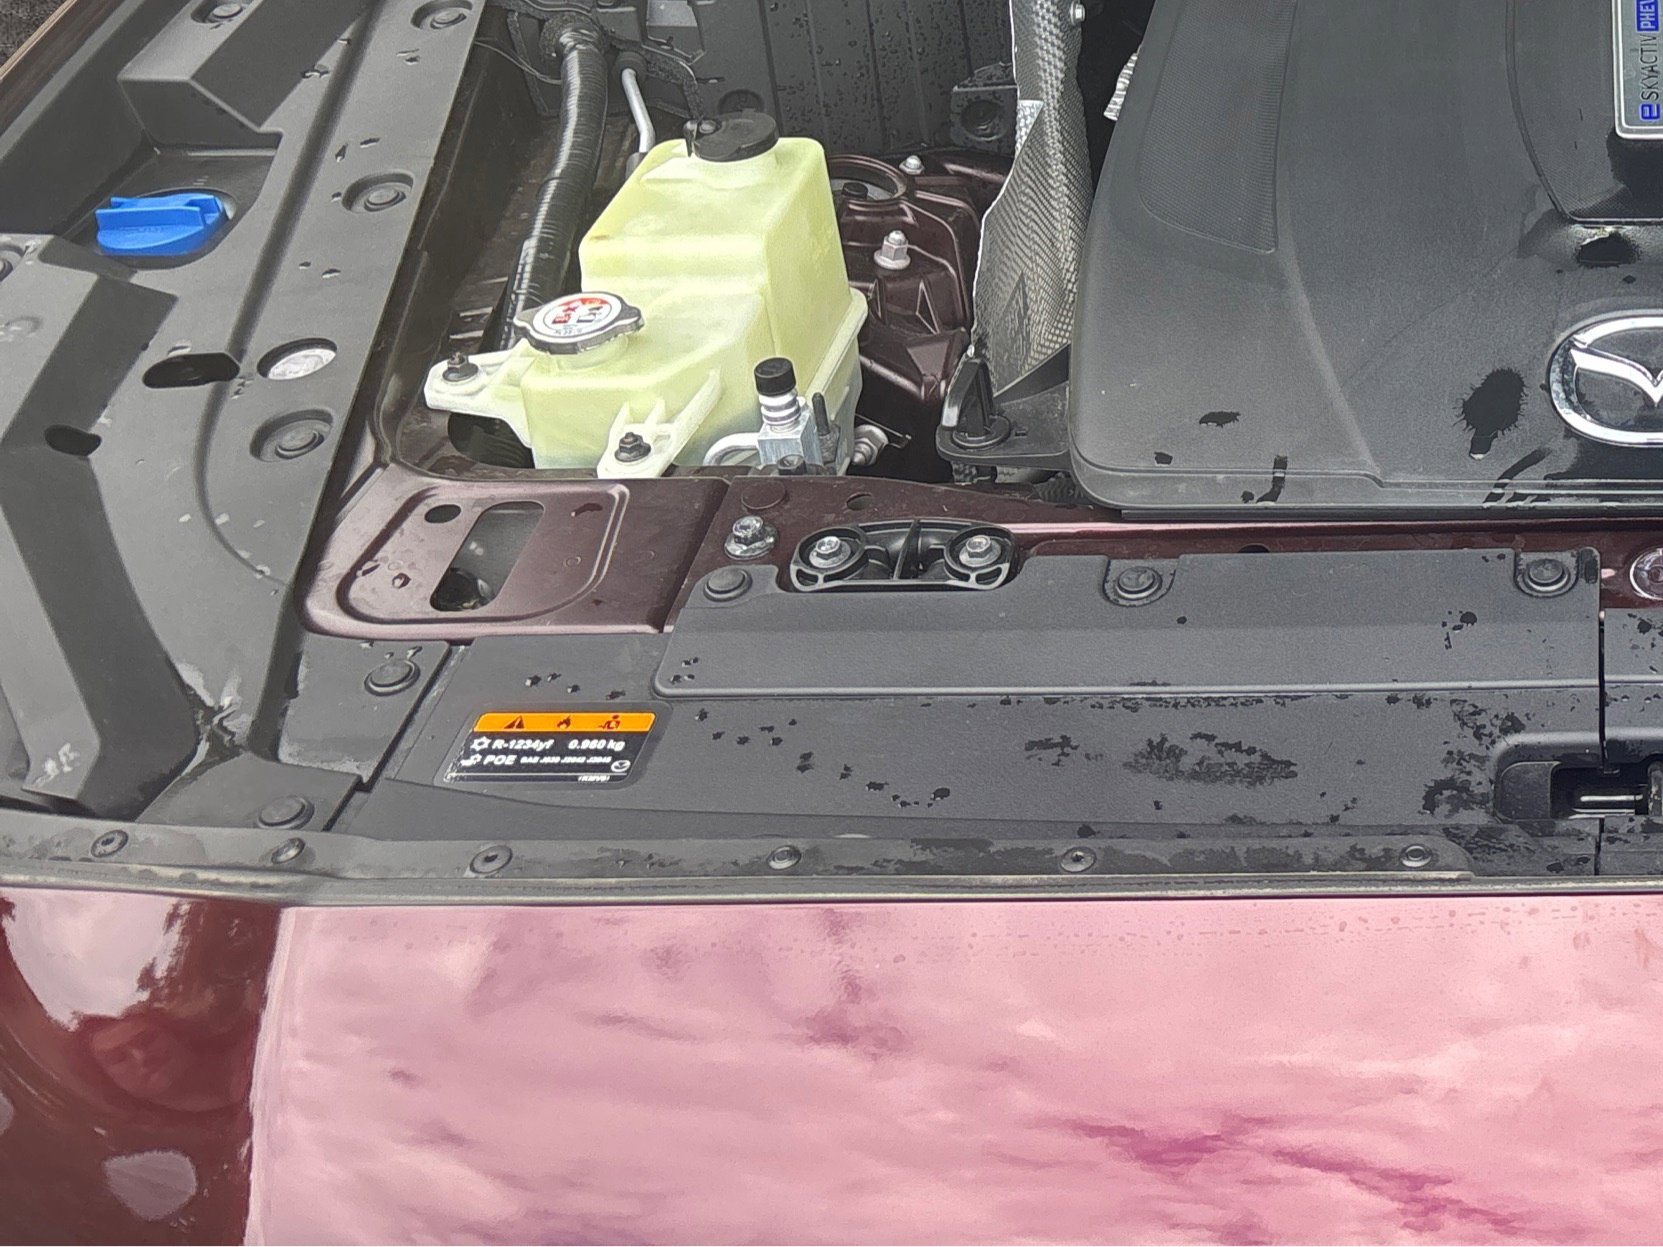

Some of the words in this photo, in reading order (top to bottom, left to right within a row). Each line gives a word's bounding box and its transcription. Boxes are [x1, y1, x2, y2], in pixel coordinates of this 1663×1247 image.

[492, 739, 554, 751] R-1234yf
[607, 739, 625, 751] kg
[483, 755, 518, 765] POE
